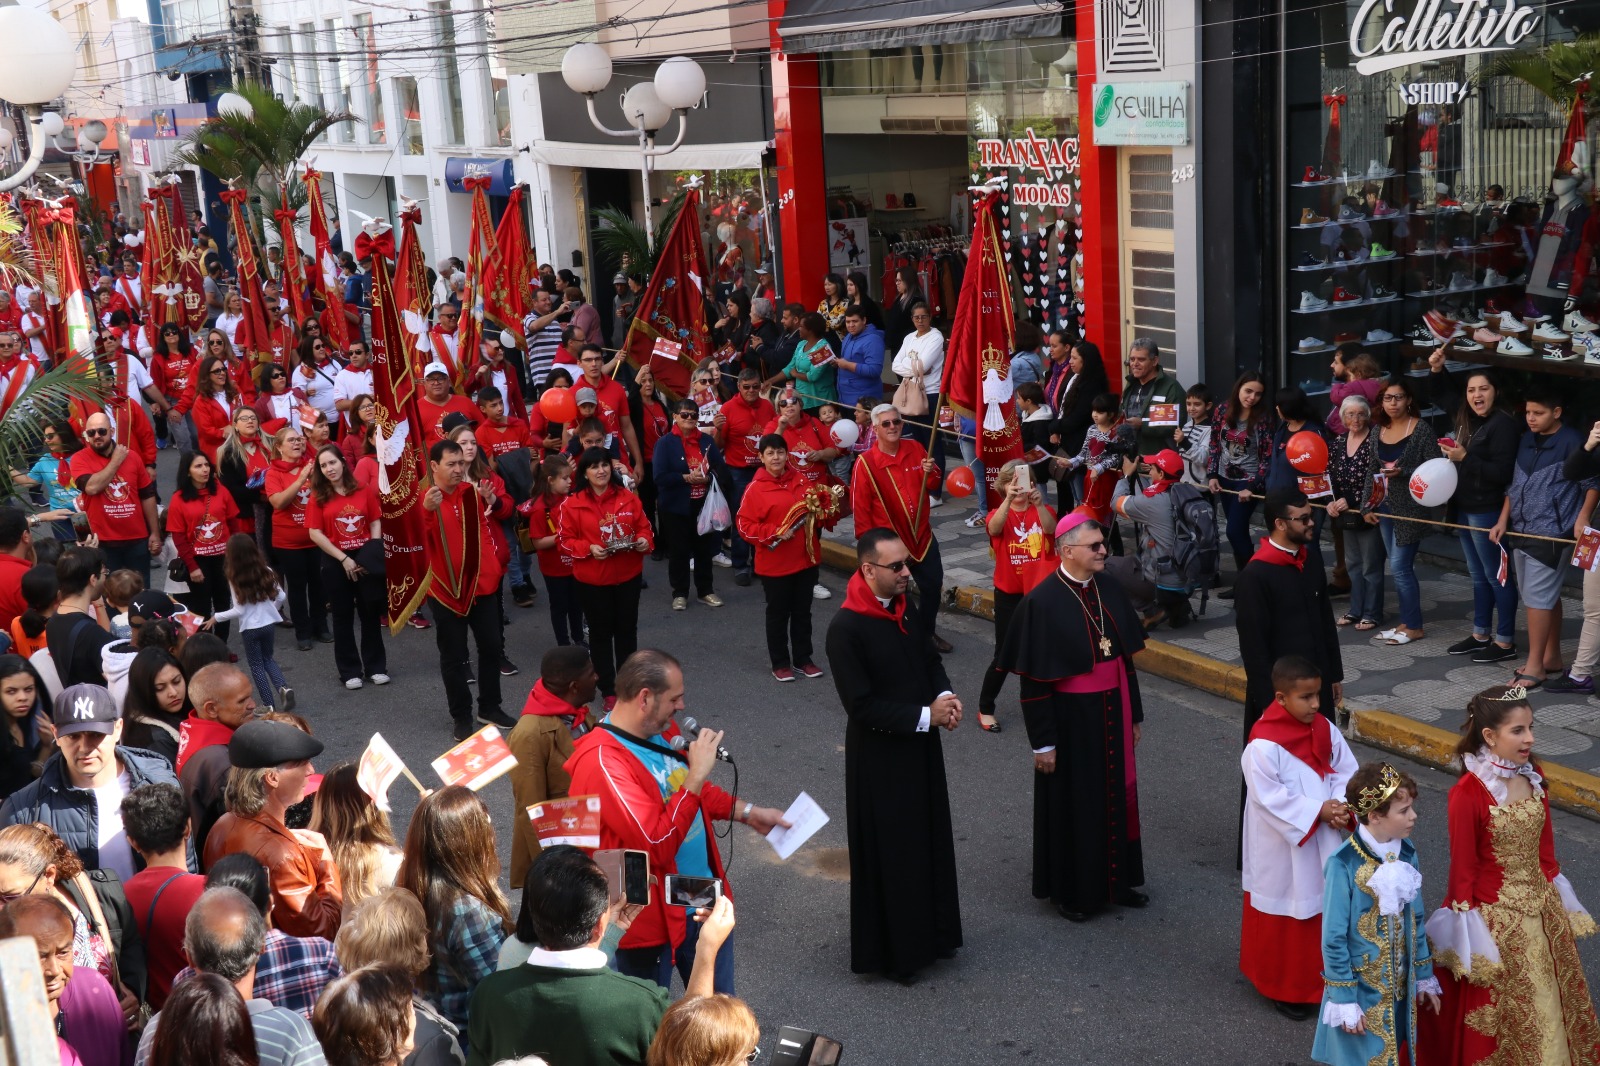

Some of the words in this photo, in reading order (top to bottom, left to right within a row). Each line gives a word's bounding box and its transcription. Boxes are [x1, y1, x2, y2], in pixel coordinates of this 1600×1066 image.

[1408, 82, 1459, 105] SHOP
[1115, 96, 1184, 118] SEVILHA
[1171, 164, 1194, 183] 243
[779, 189, 794, 209] 239
[1013, 184, 1071, 207] MODAS
[73, 696, 95, 720] NY
